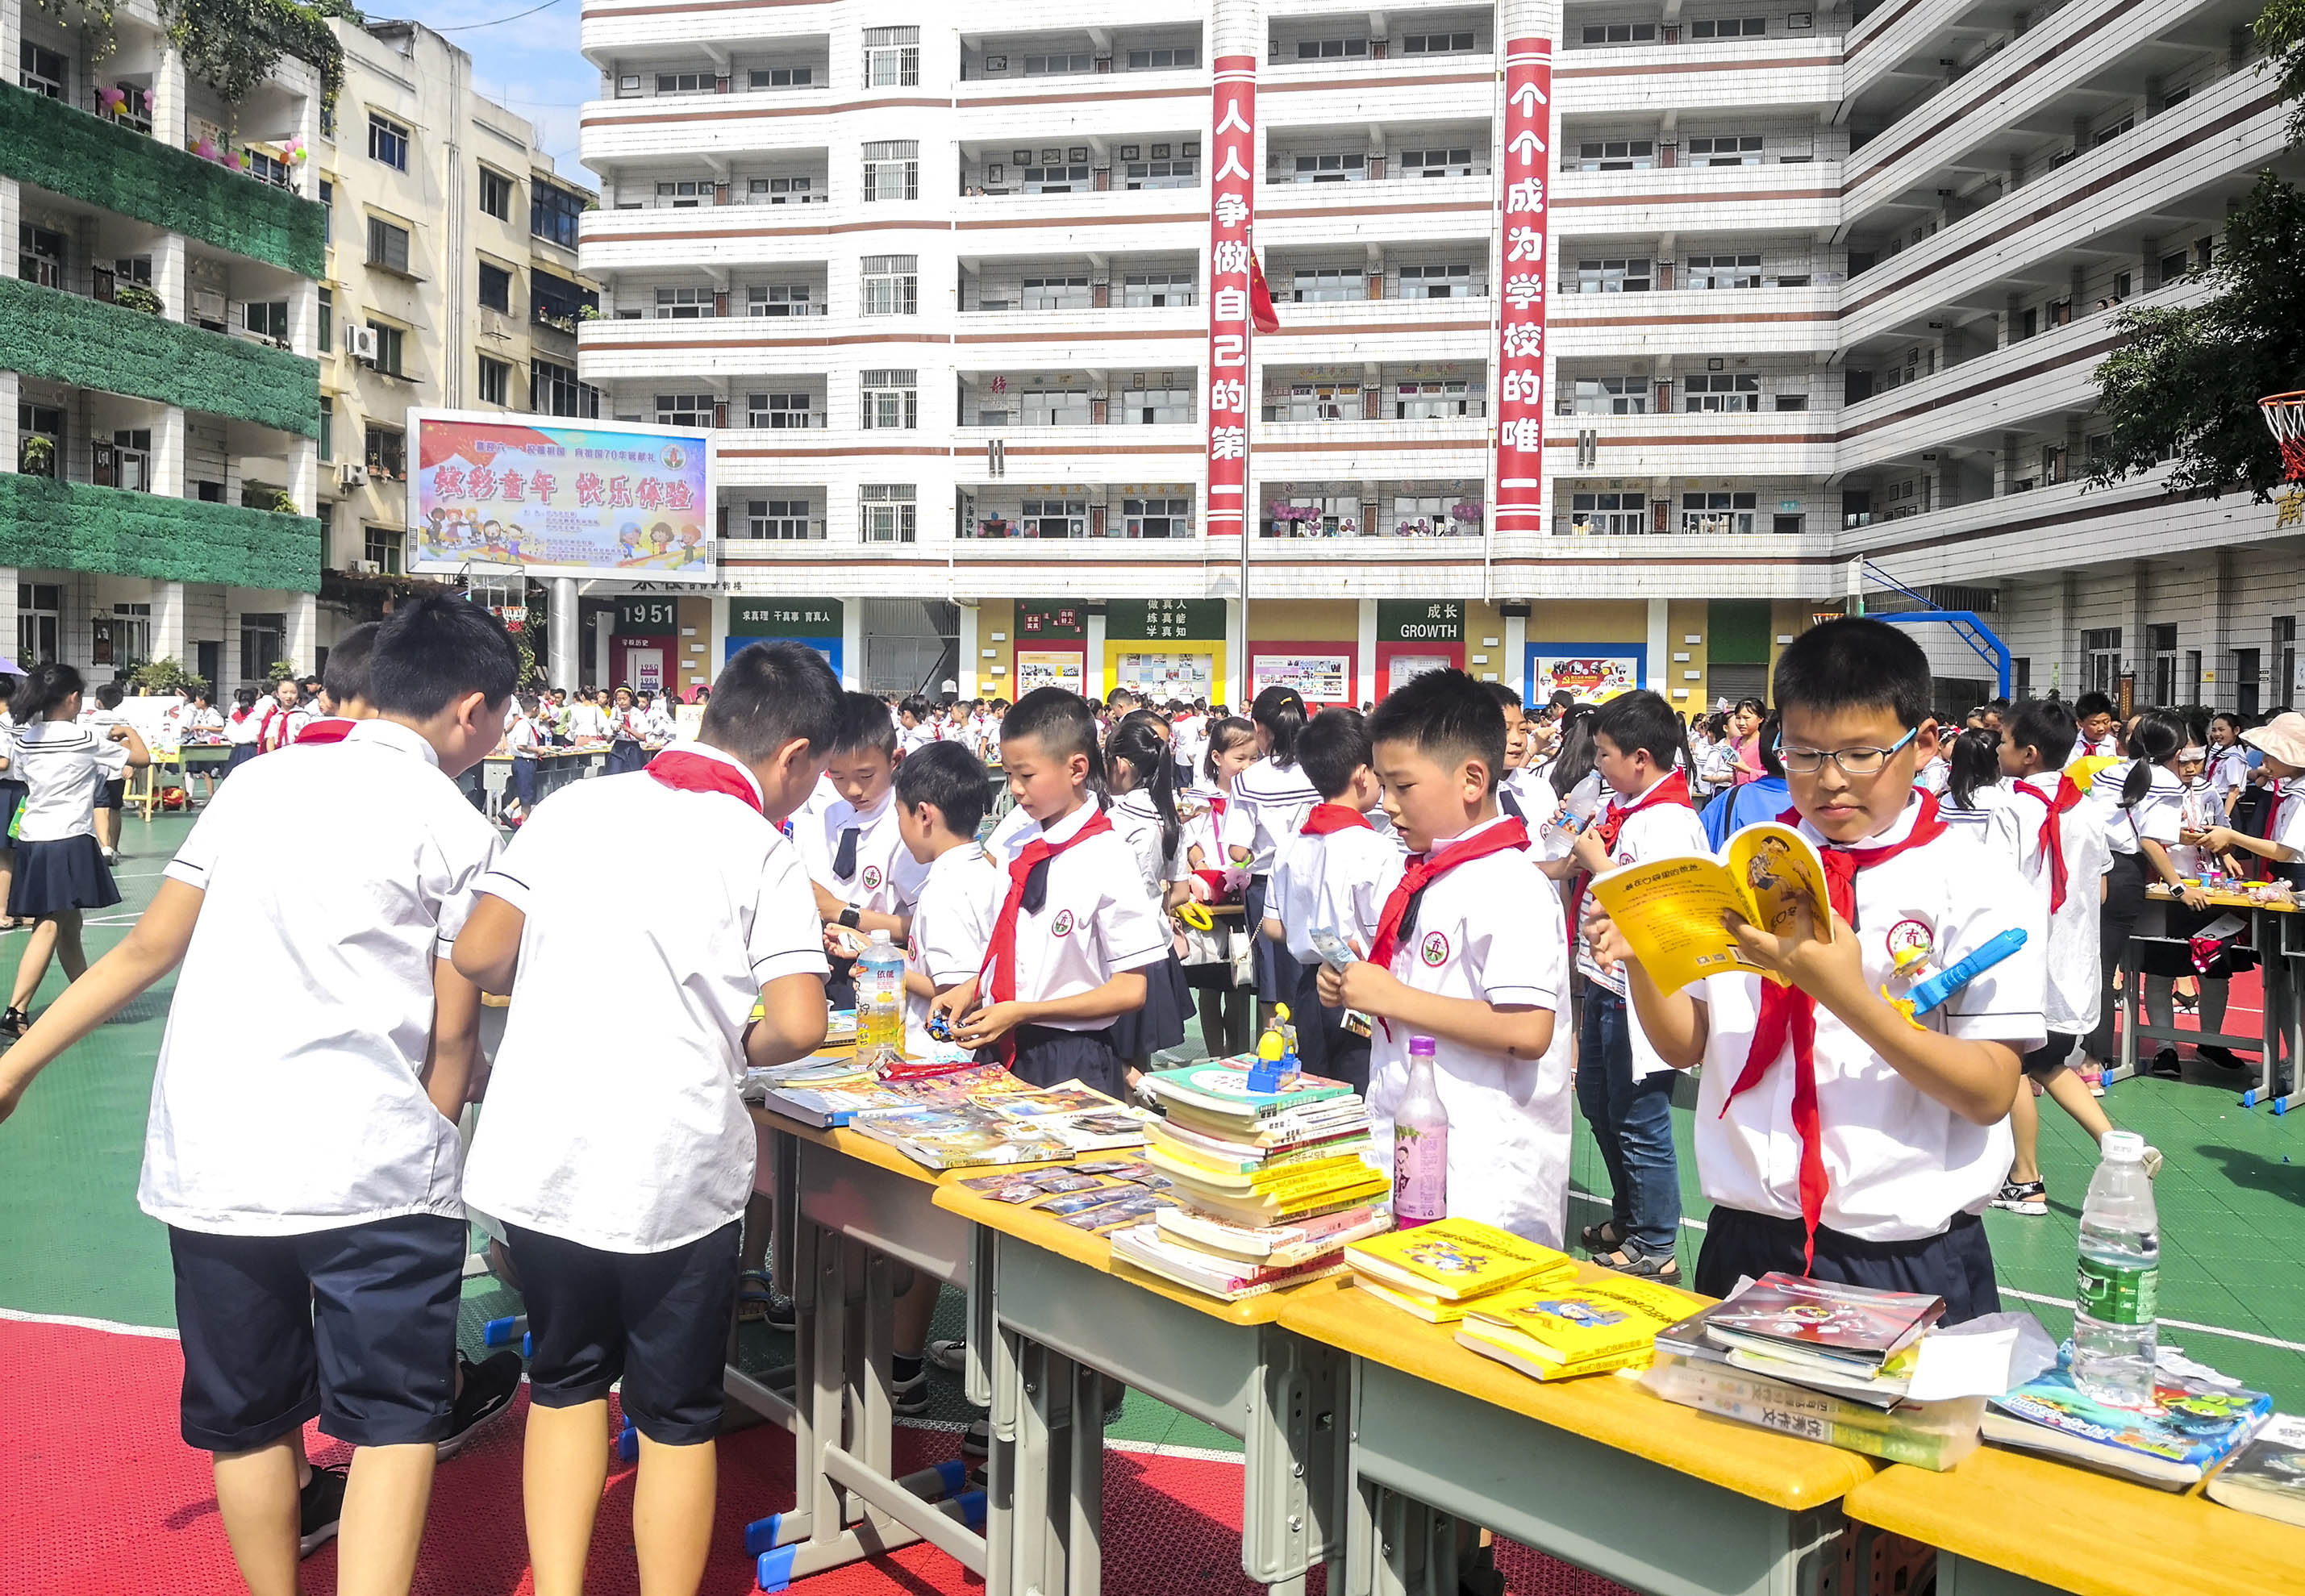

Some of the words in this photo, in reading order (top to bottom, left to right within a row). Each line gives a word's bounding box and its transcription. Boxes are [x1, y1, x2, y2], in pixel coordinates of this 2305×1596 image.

[1500, 81, 1547, 488] 个个成为学校的唯一
[1211, 98, 1250, 494] 人人争做自己的第一
[434, 465, 556, 503] 炫彩童年
[576, 472, 694, 510] 快乐体验
[1147, 599, 1187, 610] 做真人
[1427, 603, 1457, 619] 成长
[623, 604, 673, 623] 1951
[743, 610, 769, 621] 求真理
[1147, 612, 1187, 624] 练真能
[1147, 626, 1187, 637] 学真知
[1400, 624, 1457, 638] GROWTH
